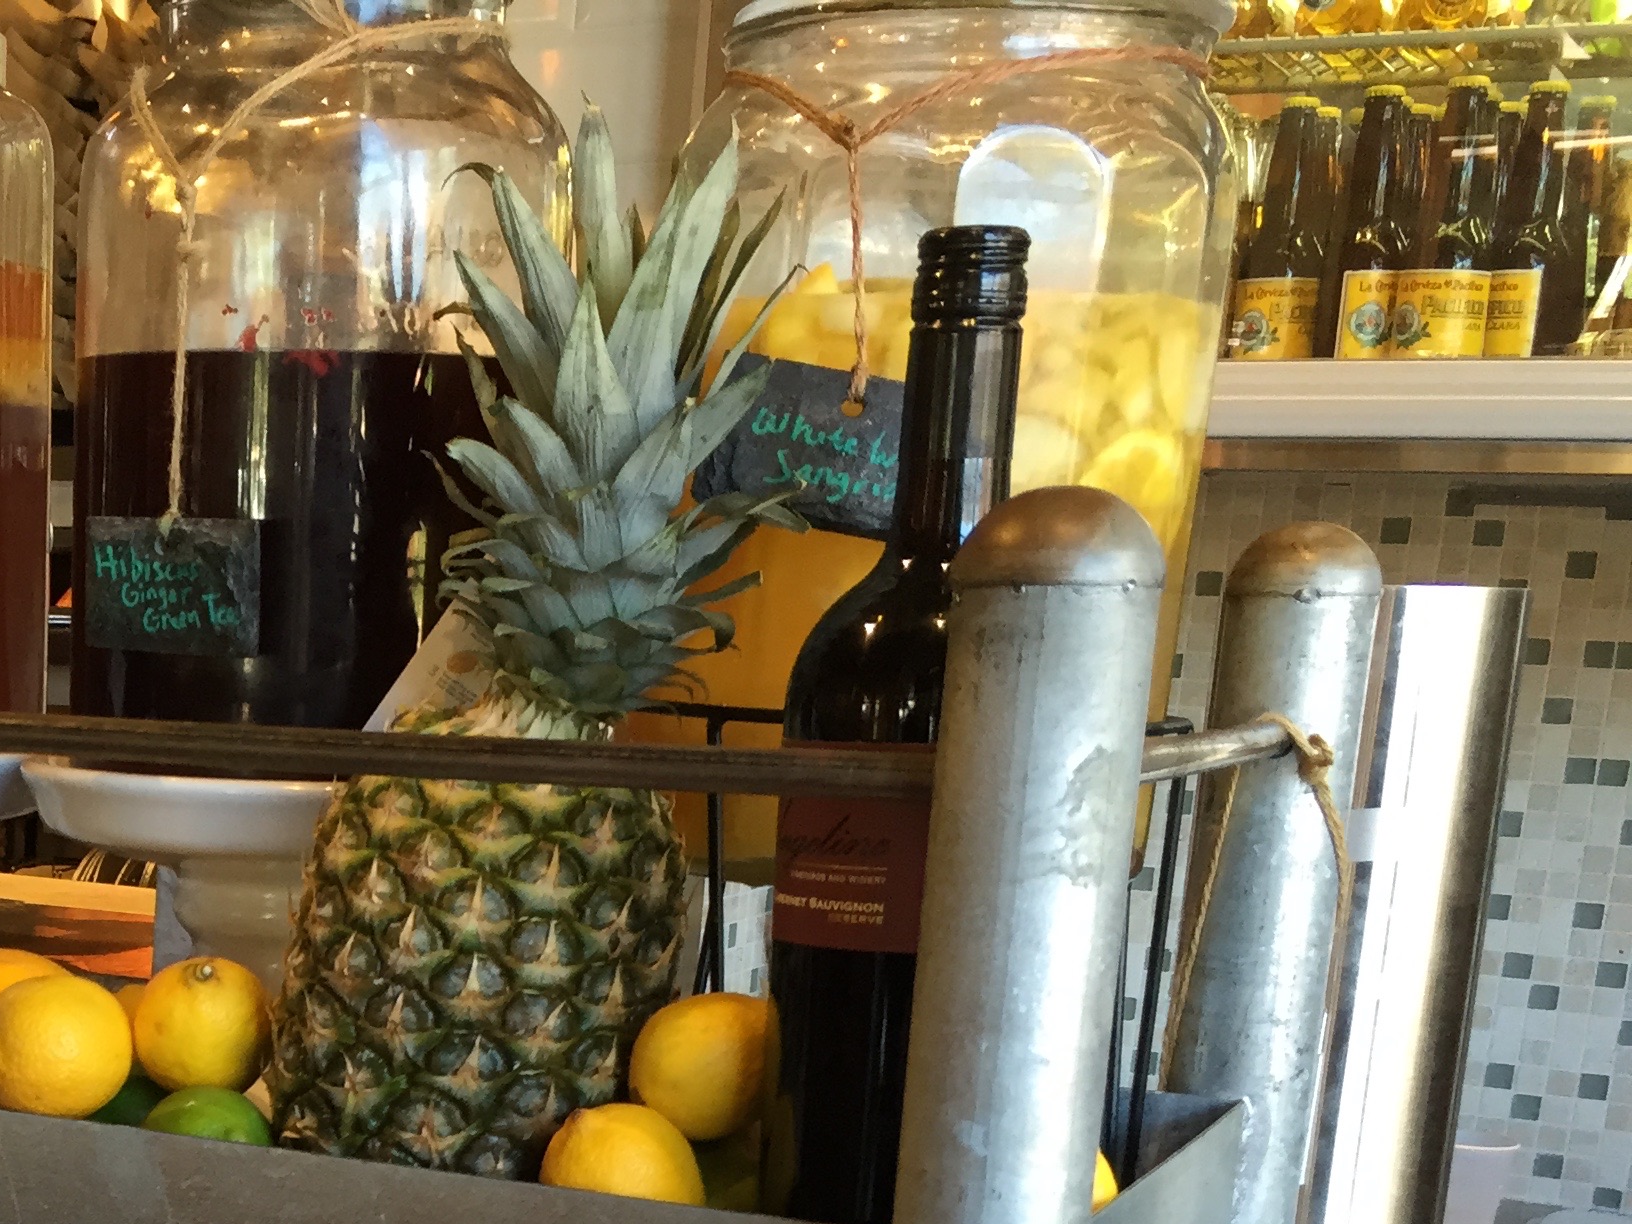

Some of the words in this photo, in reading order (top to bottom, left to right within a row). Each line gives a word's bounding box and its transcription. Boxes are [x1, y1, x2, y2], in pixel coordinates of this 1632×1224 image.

[94, 544, 200, 582] Hibiscus
[121, 582, 193, 610] Ginger
[142, 607, 202, 633] Green
[201, 592, 241, 626] Tea
[809, 896, 885, 913] SAUVIGNON
